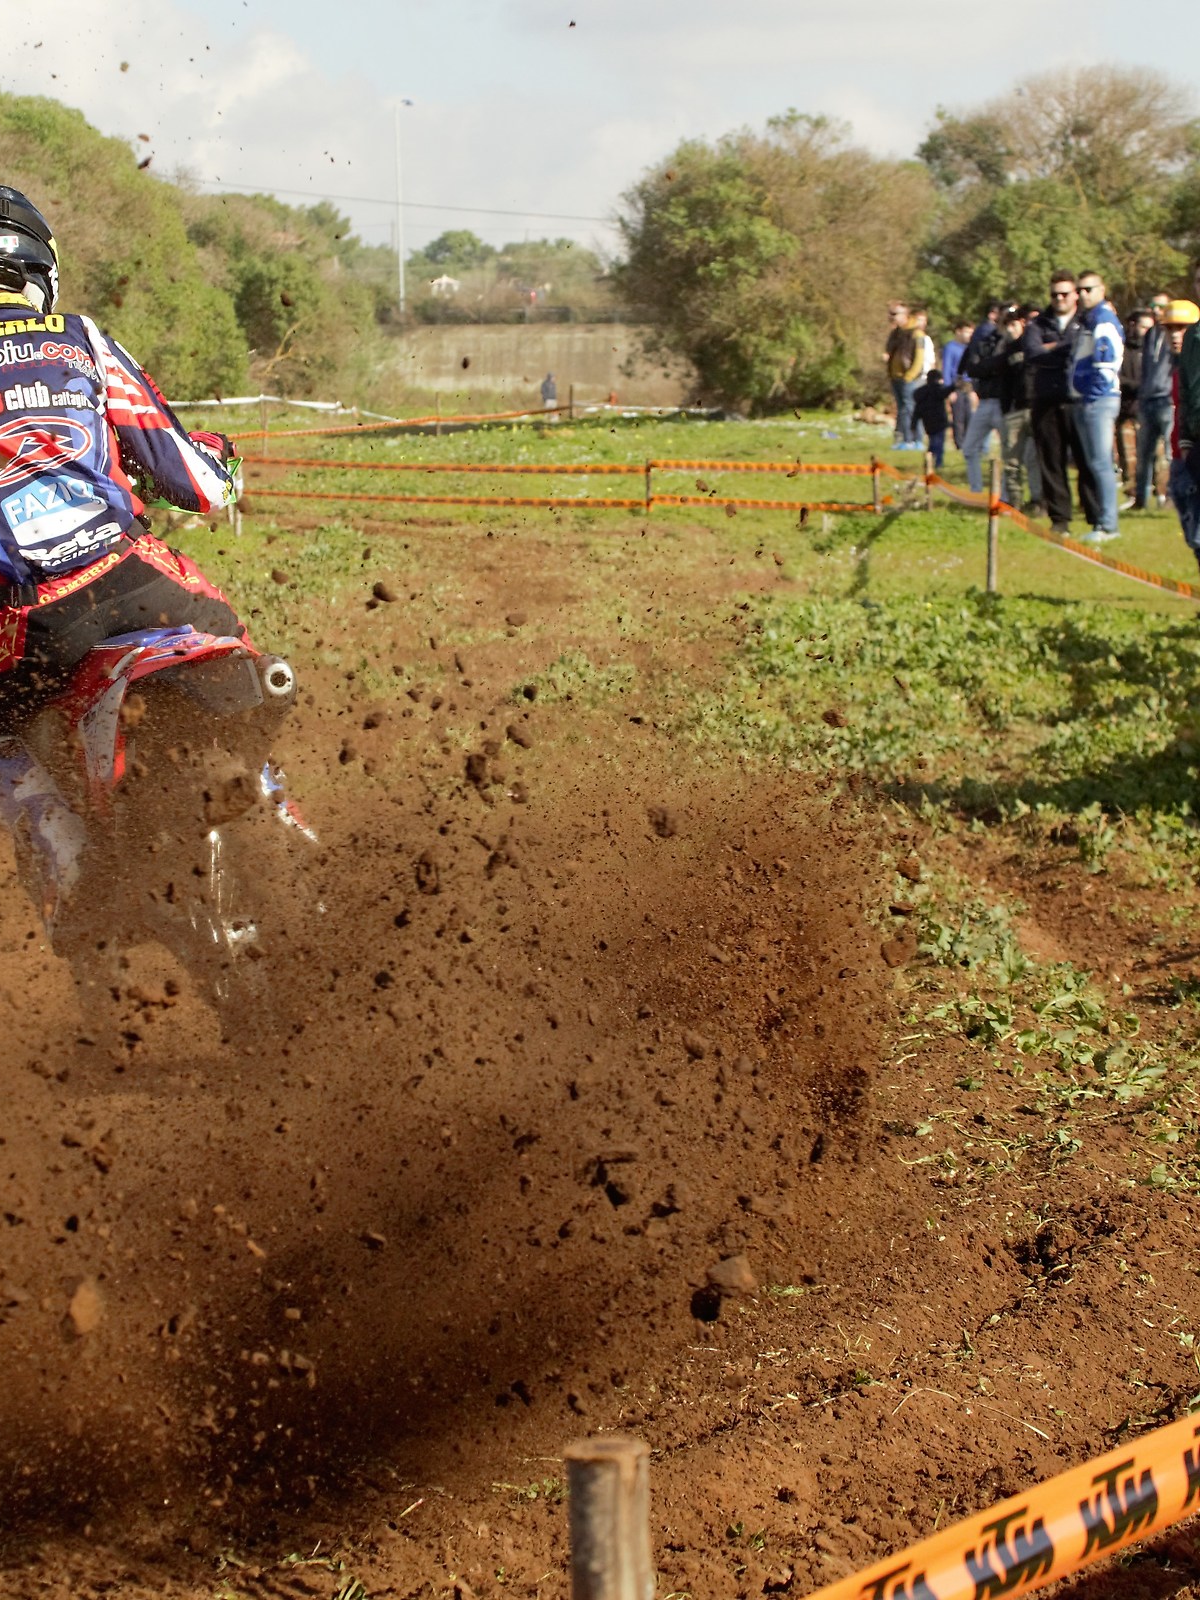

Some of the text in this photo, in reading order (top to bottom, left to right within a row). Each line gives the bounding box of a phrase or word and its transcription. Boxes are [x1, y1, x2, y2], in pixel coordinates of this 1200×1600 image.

[4, 381, 50, 411] club
[3, 478, 90, 526] FAZIO
[40, 543, 100, 567] RACING
[56, 552, 121, 596] SMERLO
[964, 1506, 1056, 1600] KTM
[1078, 1456, 1160, 1561] KTM
